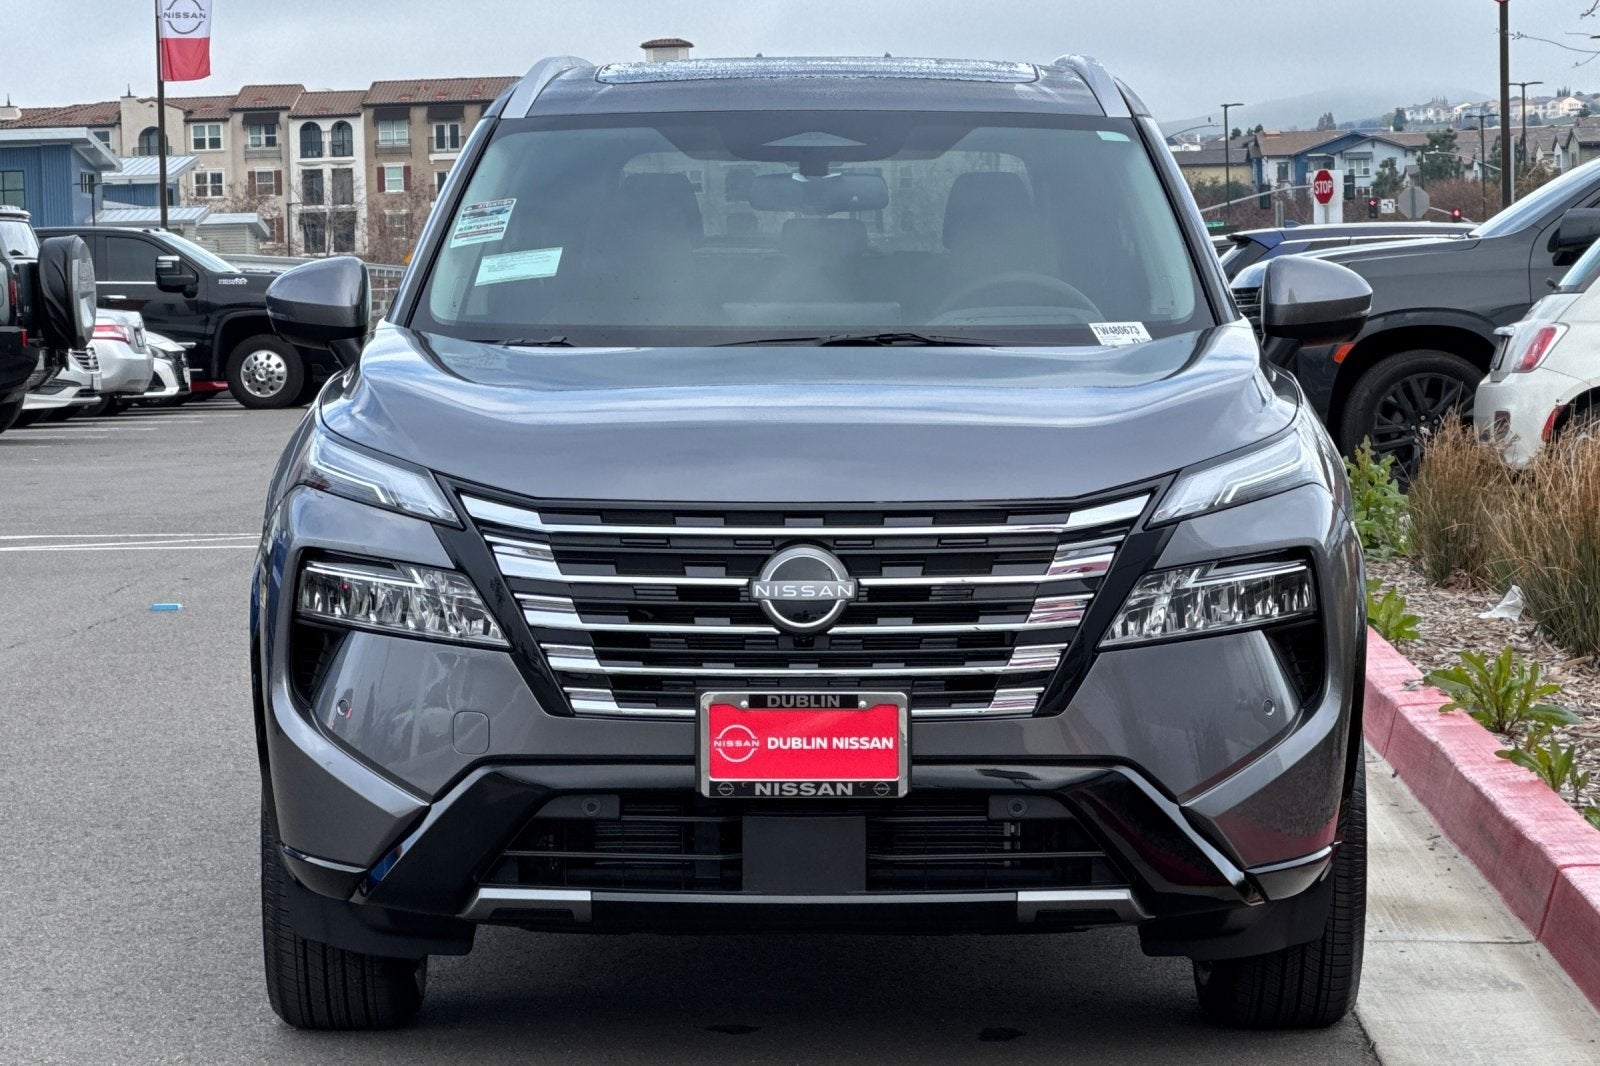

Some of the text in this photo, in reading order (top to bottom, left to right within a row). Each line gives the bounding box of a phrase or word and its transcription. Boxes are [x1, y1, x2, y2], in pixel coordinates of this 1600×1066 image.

[1314, 180, 1333, 194] STOP
[755, 584, 853, 597] NISSAN
[767, 694, 840, 708] DUBLIN
[713, 740, 760, 748] NISSAN
[767, 736, 893, 750] DUBLIN NISSAN
[754, 782, 853, 796] NISSAN
